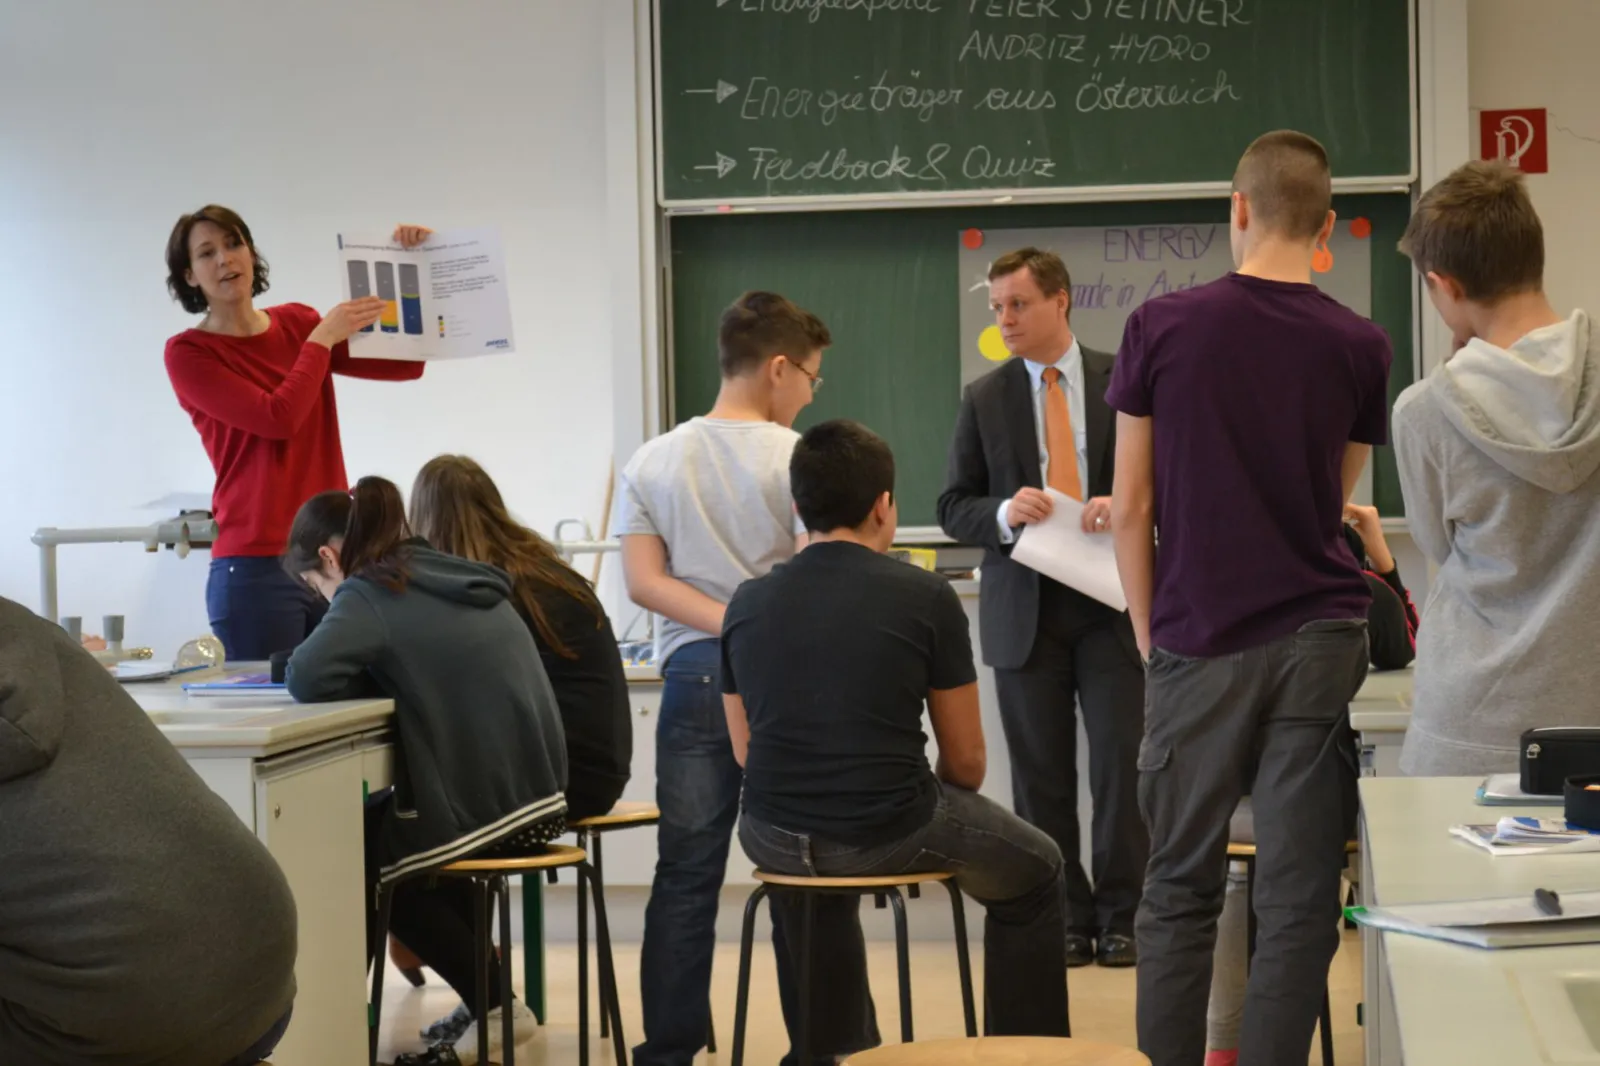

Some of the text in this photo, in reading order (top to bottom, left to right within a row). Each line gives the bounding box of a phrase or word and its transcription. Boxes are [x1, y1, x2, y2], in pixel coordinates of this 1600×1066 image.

[1109, 32, 1211, 64] HYDRO
[740, 69, 1241, 126] Energieträger aus Österreich
[748, 140, 1056, 181] Feedback & Quiz
[1104, 226, 1216, 262] ENERGY
